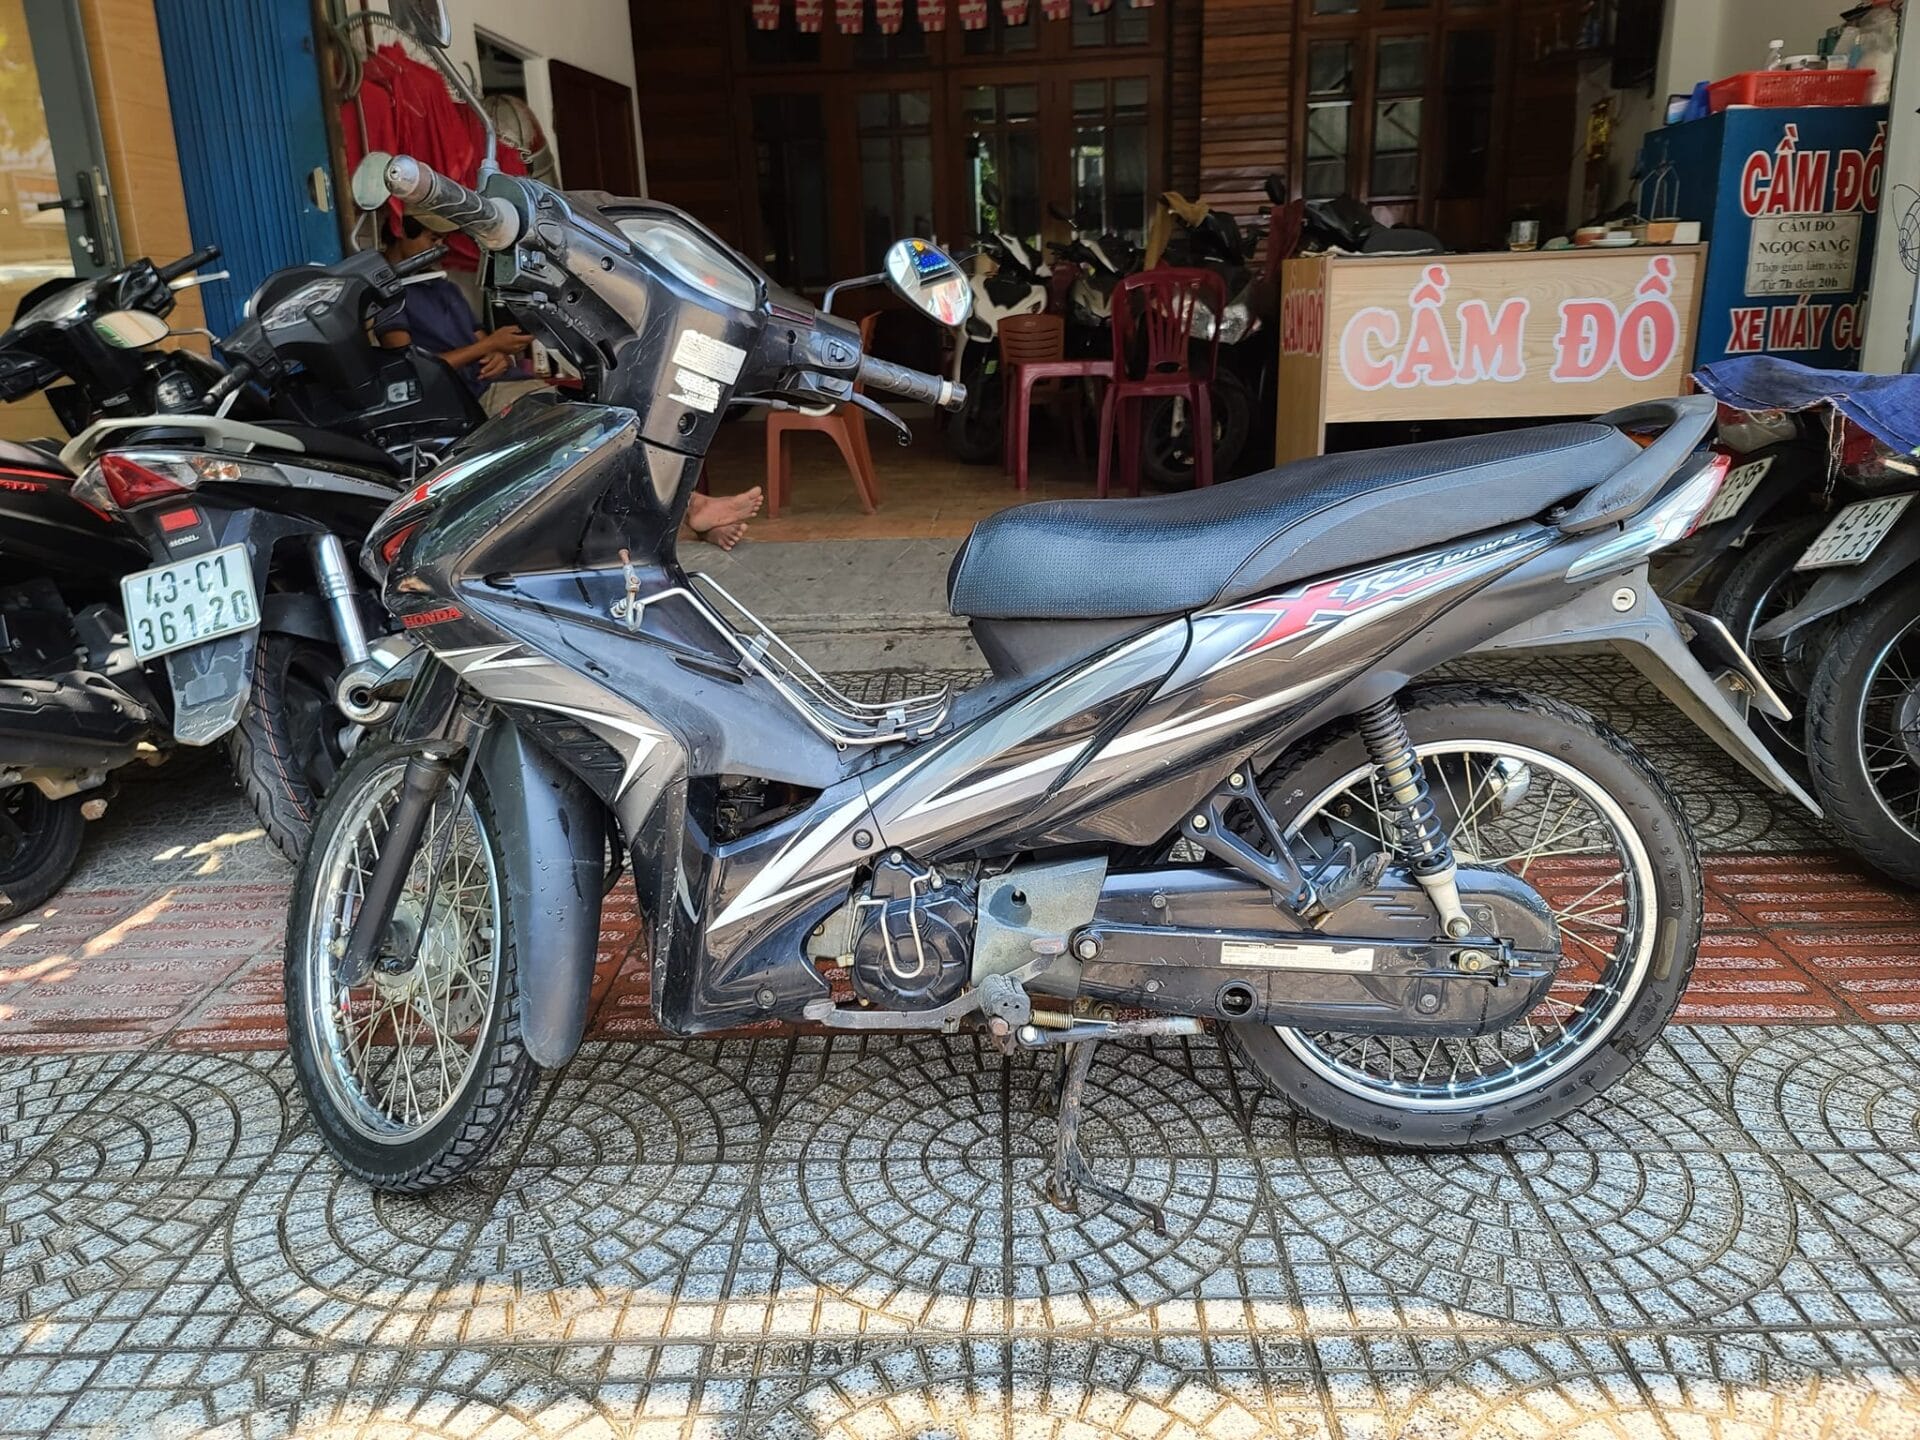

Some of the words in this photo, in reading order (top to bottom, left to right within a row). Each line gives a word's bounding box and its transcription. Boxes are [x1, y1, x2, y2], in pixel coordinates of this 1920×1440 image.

[1741, 123, 1830, 218] CẦM
[1759, 240, 1805, 256] NGỌC
[1808, 239, 1850, 252] SANG
[1779, 279, 1793, 289] 7h
[1817, 277, 1839, 288] 20h
[1340, 264, 1531, 390] CẦM
[1550, 254, 1680, 382] ĐỒ
[1724, 307, 1768, 353] XE
[1767, 293, 1833, 352] MÁY
[145, 555, 229, 608] 43-C1
[138, 590, 250, 652] 361.20
[402, 608, 462, 627] HONDA
